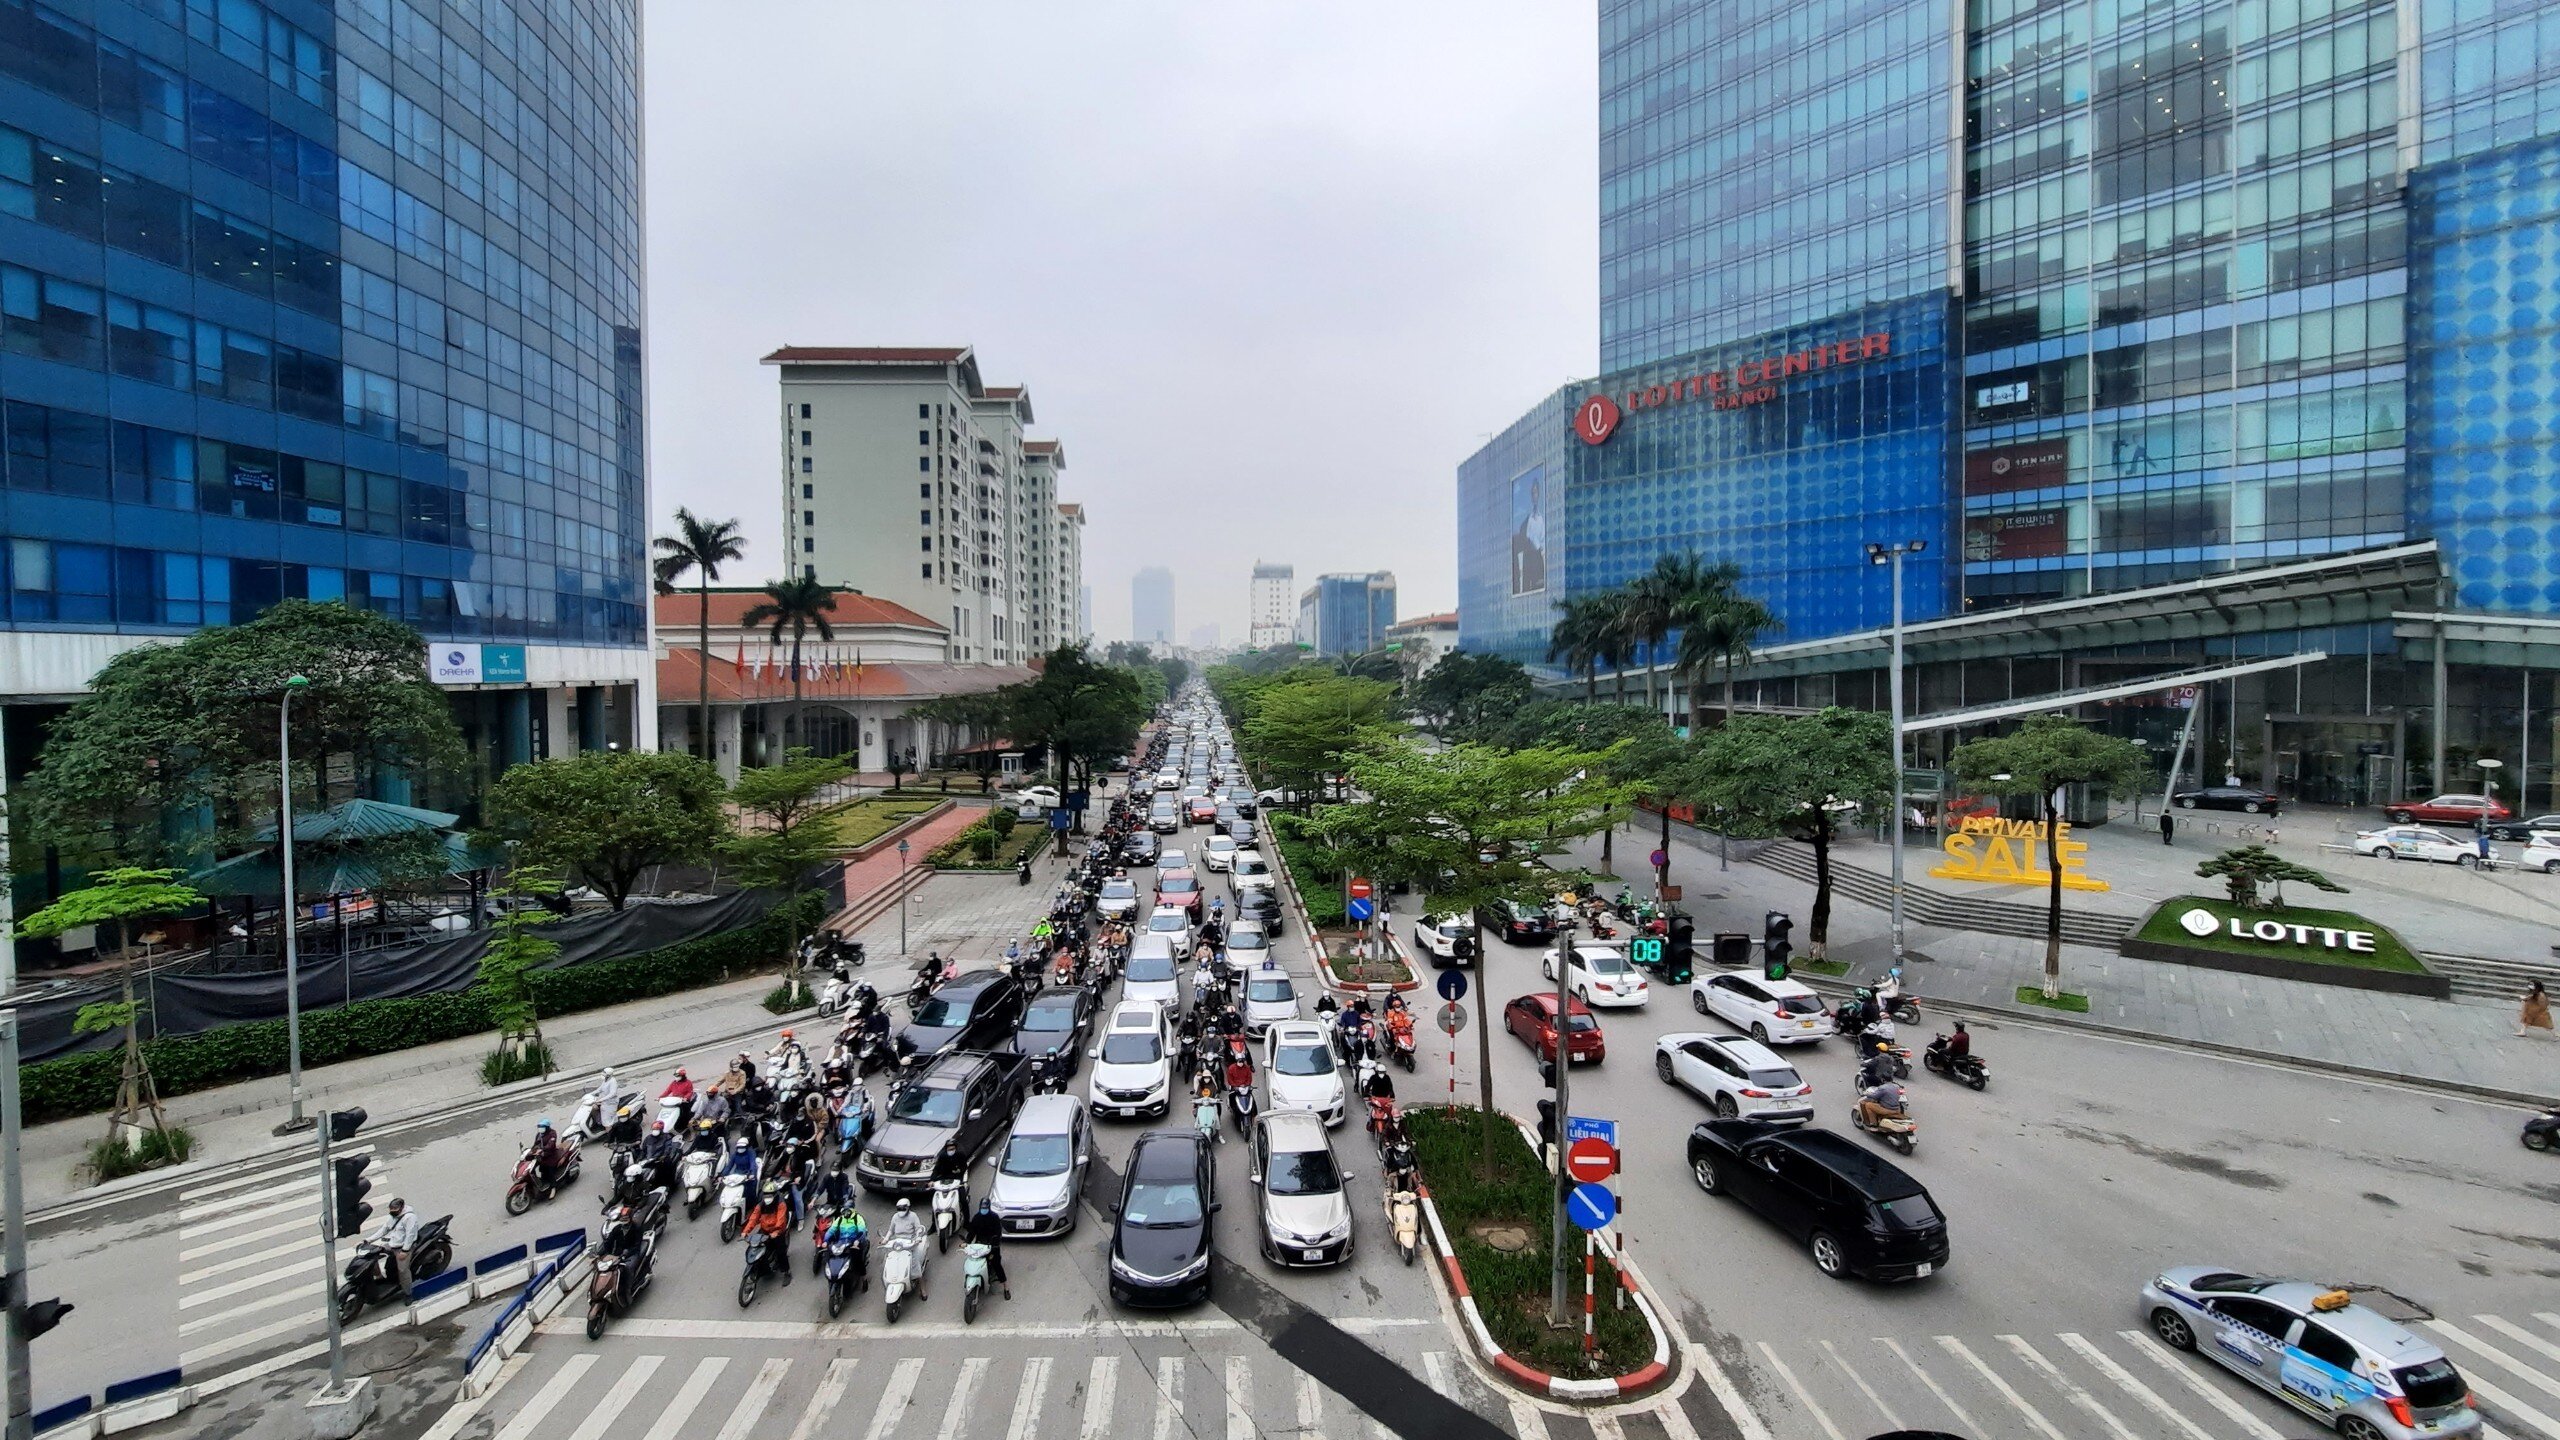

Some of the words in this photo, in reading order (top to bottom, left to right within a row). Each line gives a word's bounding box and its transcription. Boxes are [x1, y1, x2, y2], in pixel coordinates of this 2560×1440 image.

[1628, 371, 1726, 411] LOTTE
[1737, 332, 1892, 387] CENTER
[1714, 386, 1778, 411] HANOI
[440, 668, 474, 676] DAEHA
[1960, 815, 2072, 841] PRIVATE
[1944, 833, 2088, 880] SALE
[2229, 917, 2376, 953] LOTTE
[1633, 939, 1662, 962] 08
